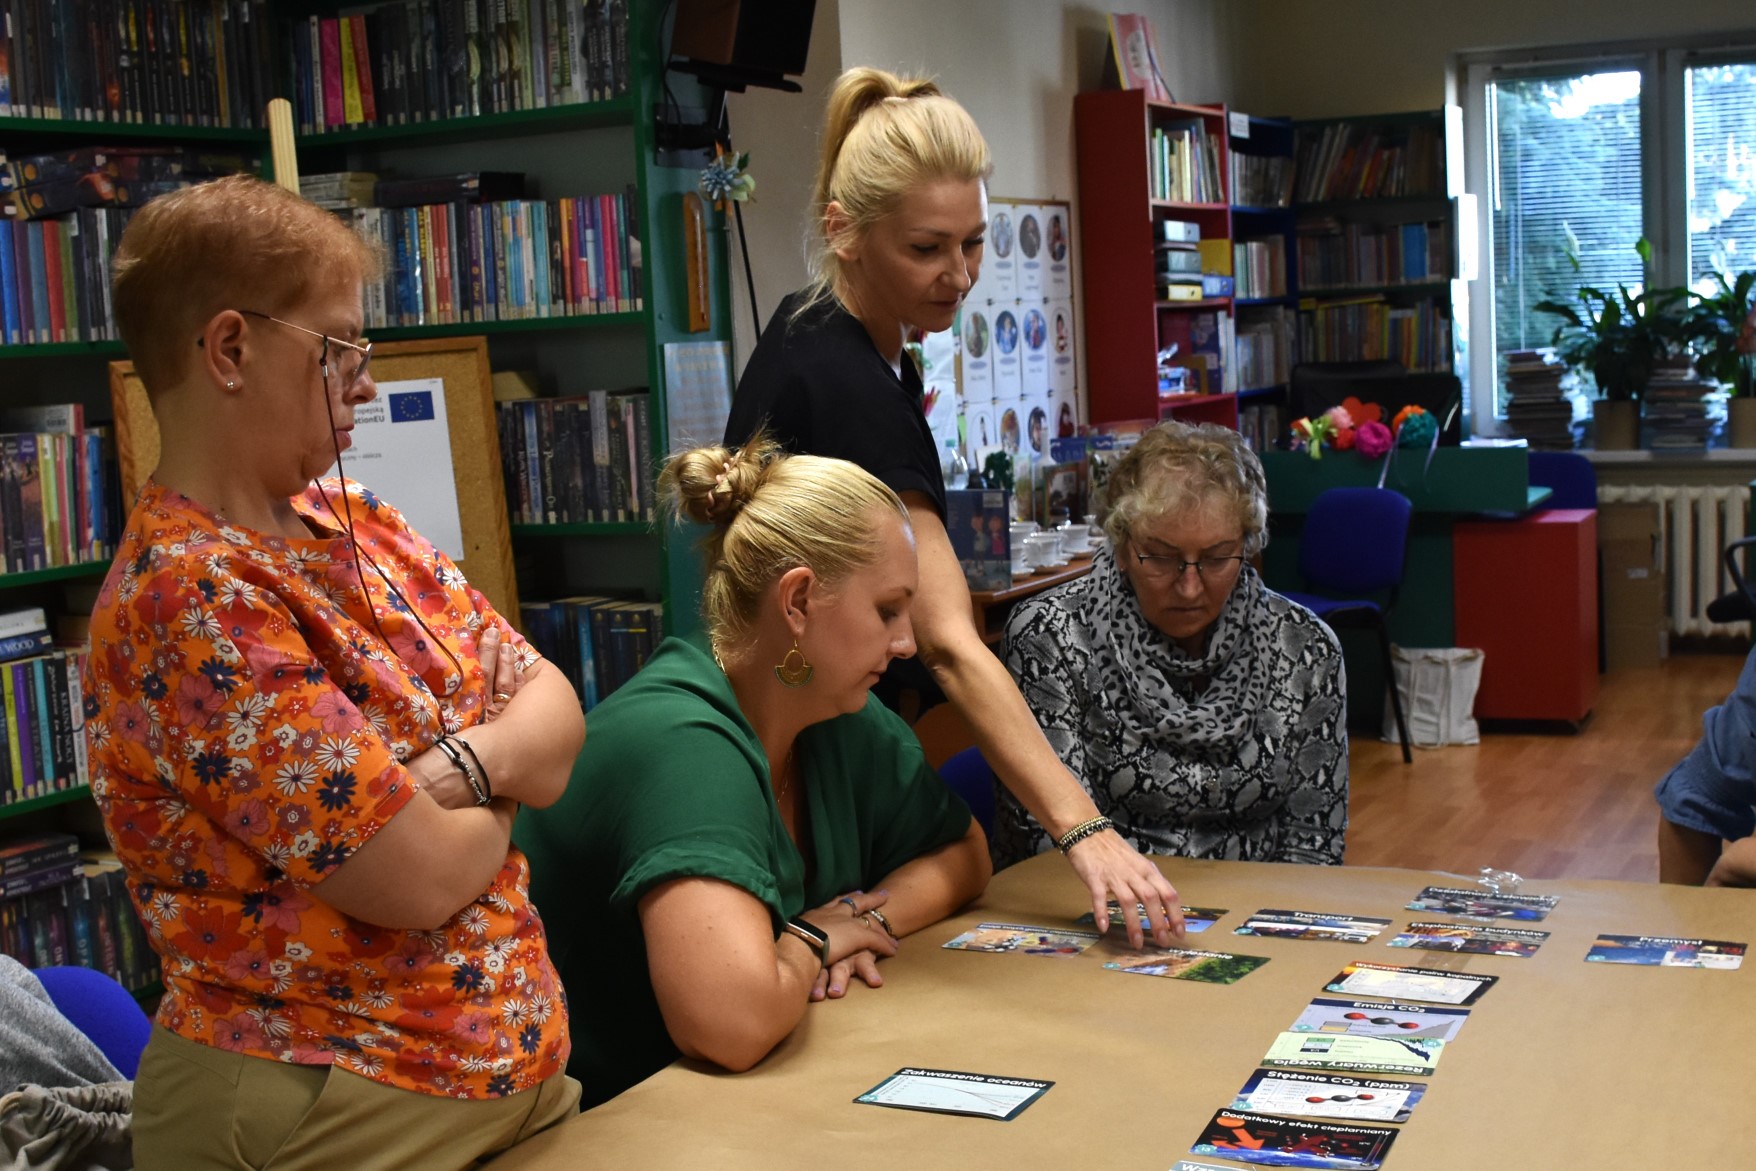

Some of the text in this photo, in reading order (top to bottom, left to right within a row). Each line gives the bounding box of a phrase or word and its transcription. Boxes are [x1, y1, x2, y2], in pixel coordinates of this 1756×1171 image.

[354, 407, 383, 415] ropejską
[354, 416, 385, 424] ationEU
[1294, 911, 1353, 922] Transport
[1411, 922, 1545, 937] Eksploatacja budynków
[1168, 947, 1234, 960] Wylesianie
[1355, 962, 1492, 982] Wykorzystanie paliw kopalnych
[1353, 1001, 1396, 1011] Emisje
[1273, 1058, 1424, 1074] Rezerwuary węgla
[901, 1068, 1047, 1089] Zakwaszenie oceanów
[1266, 1070, 1329, 1085] Stężenie
[1364, 1080, 1411, 1091] (ppm)
[1221, 1110, 1393, 1136] Dodatkowy efekt cieplarniany
